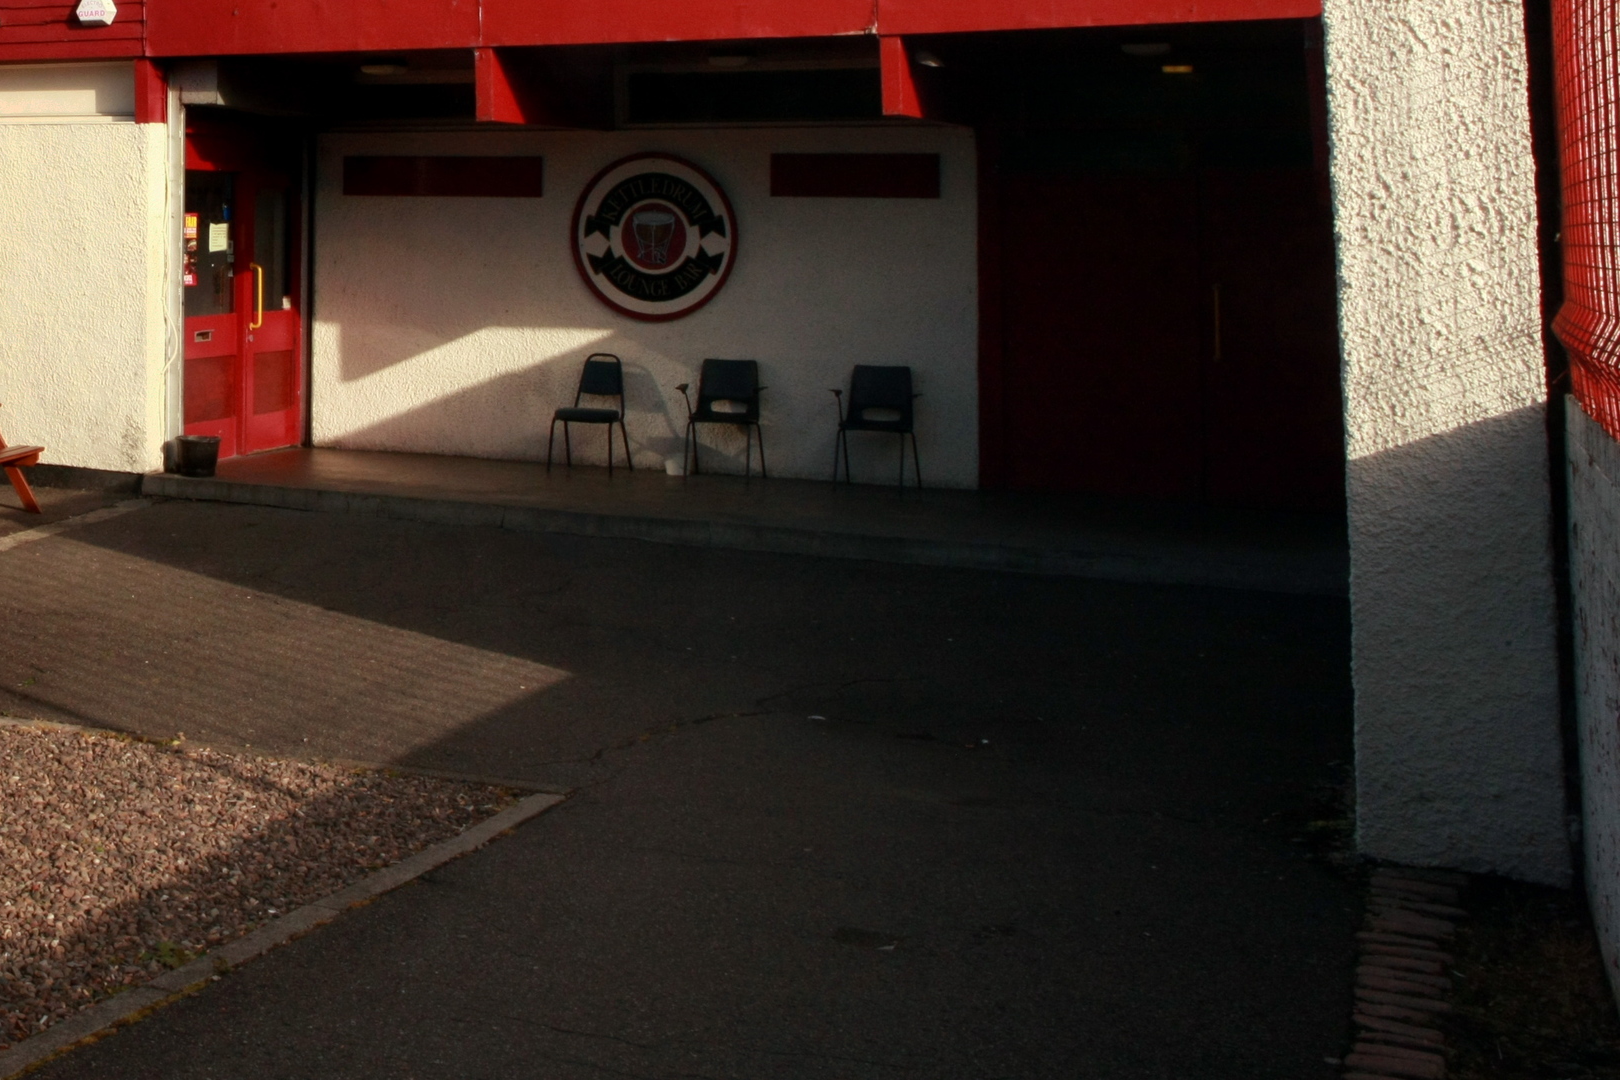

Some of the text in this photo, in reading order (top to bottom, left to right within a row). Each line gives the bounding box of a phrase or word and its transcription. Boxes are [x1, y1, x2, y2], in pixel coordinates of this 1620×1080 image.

[600, 177, 708, 222] KETTLEDRUM
[609, 261, 705, 296] LOUNGE BAR
